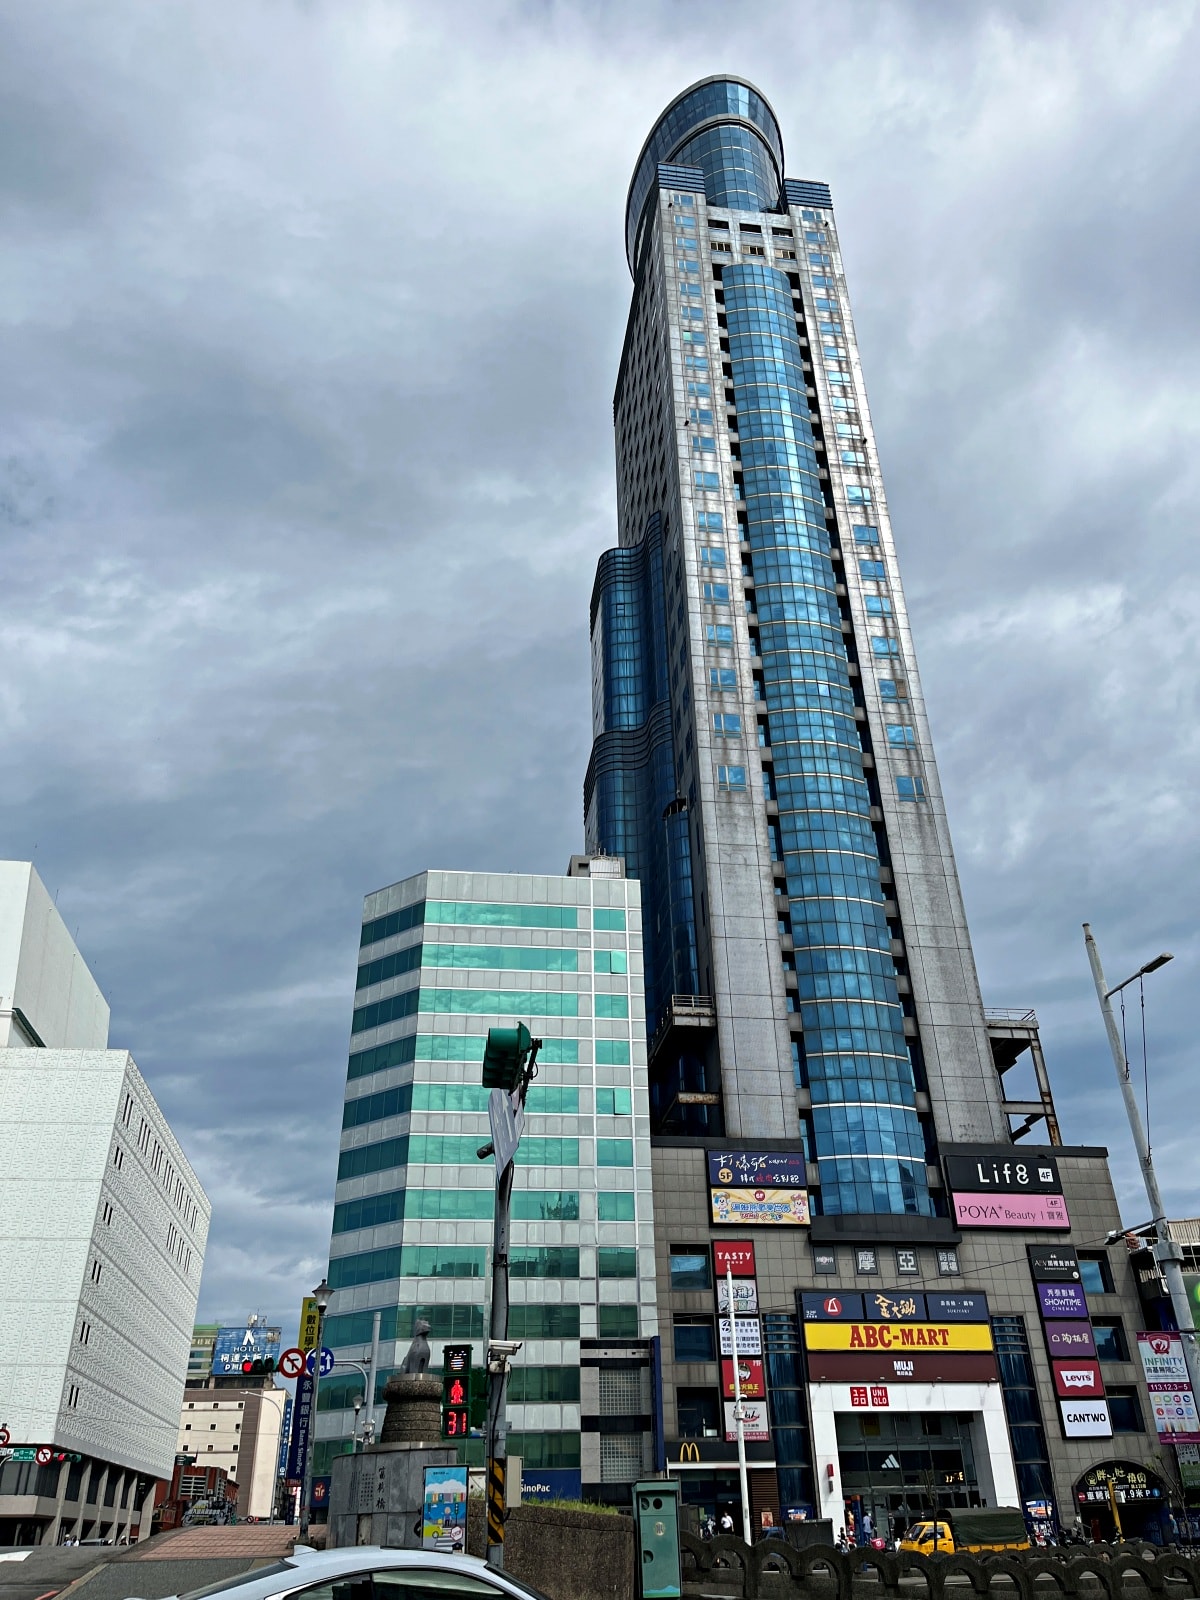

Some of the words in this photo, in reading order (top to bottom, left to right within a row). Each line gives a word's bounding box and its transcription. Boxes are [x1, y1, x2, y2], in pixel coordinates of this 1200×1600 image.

[720, 1171, 732, 1180] 5F
[1041, 1172, 1051, 1180] 4F
[958, 1205, 1000, 1219] POYA
[1004, 1209, 1036, 1222] Beauty
[717, 1252, 751, 1260] TASTY
[858, 1251, 876, 1270] 摩
[897, 1251, 917, 1271] 亞
[1046, 1288, 1075, 1297] 秀泰影城
[850, 1325, 949, 1348] ABC-MART
[1061, 1333, 1089, 1344] 陶板屋
[893, 1360, 914, 1371] MUJI
[1144, 1357, 1183, 1366] INFINITY
[872, 1389, 886, 1397] UNI
[299, 1380, 313, 1428] 永豐銀行
[873, 1397, 888, 1405] QLO
[1066, 1413, 1107, 1423] CANTWO
